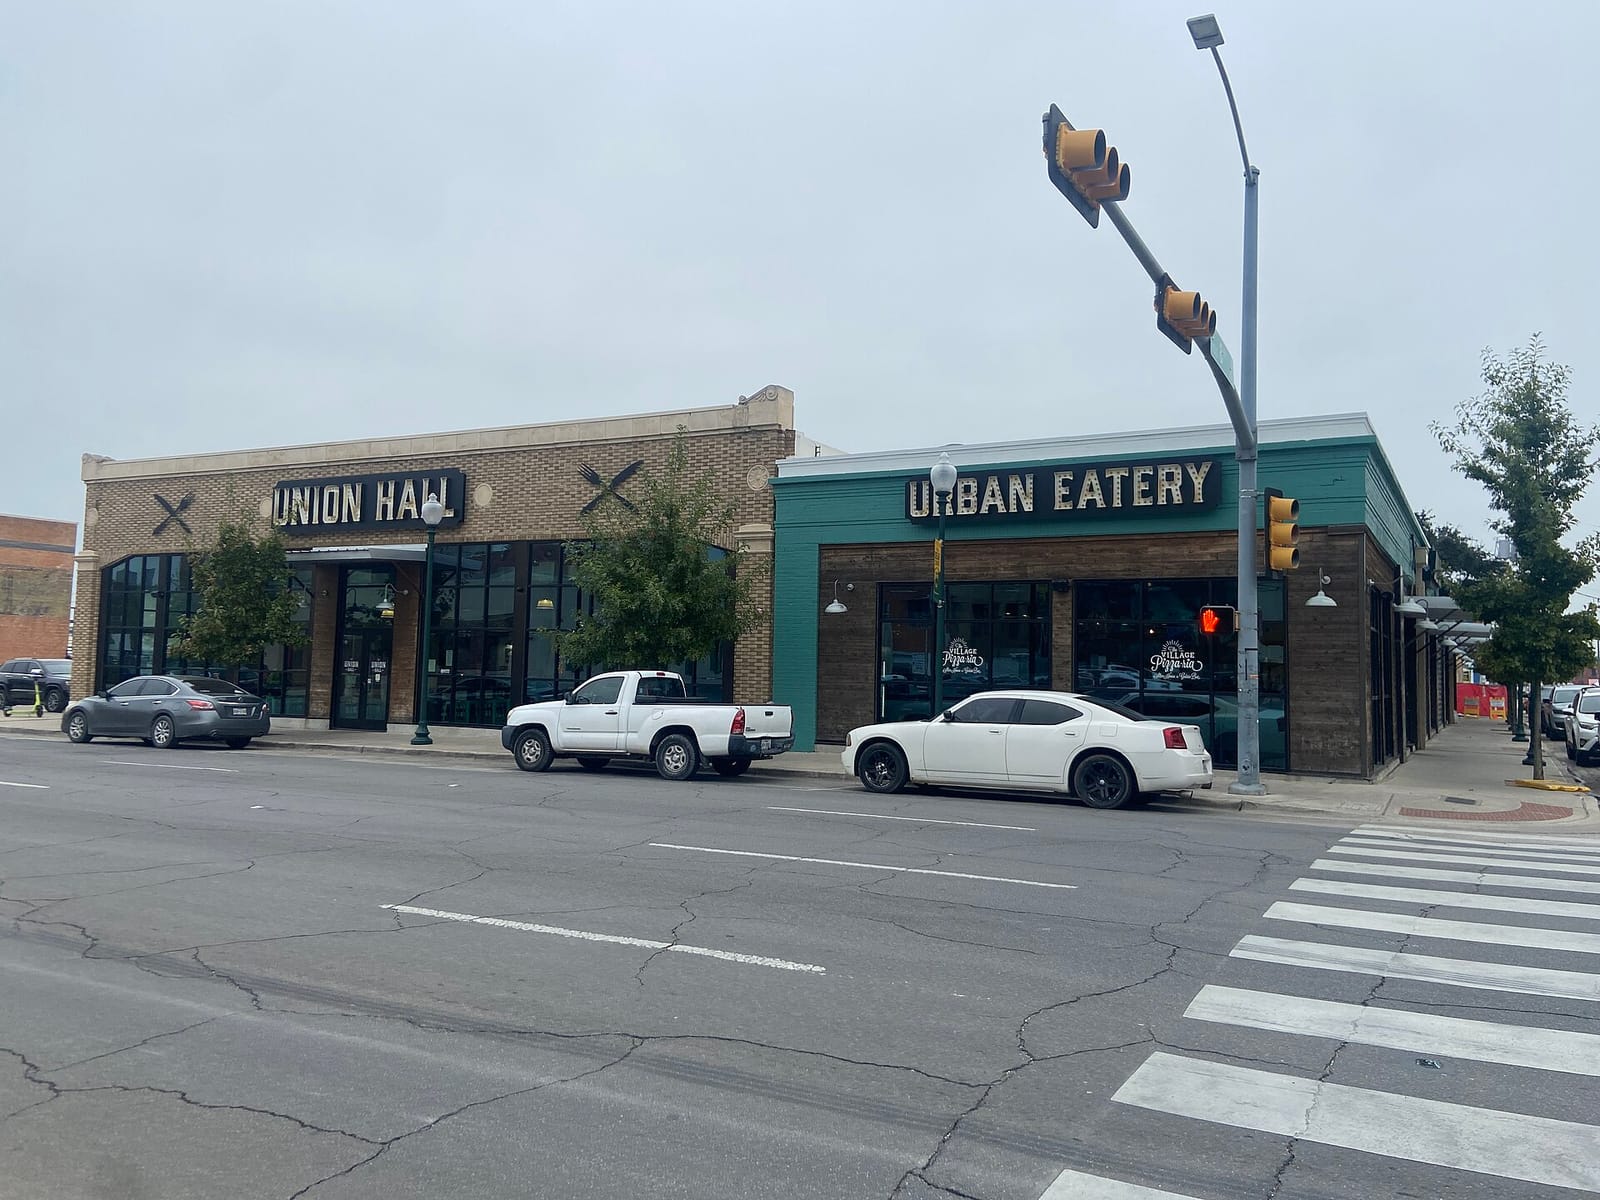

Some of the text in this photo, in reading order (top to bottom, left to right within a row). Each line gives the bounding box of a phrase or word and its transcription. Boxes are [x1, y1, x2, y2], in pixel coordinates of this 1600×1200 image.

[272, 481, 363, 527] UNION
[1053, 461, 1213, 511] EATERY
[1161, 651, 1195, 659] VILLAGE
